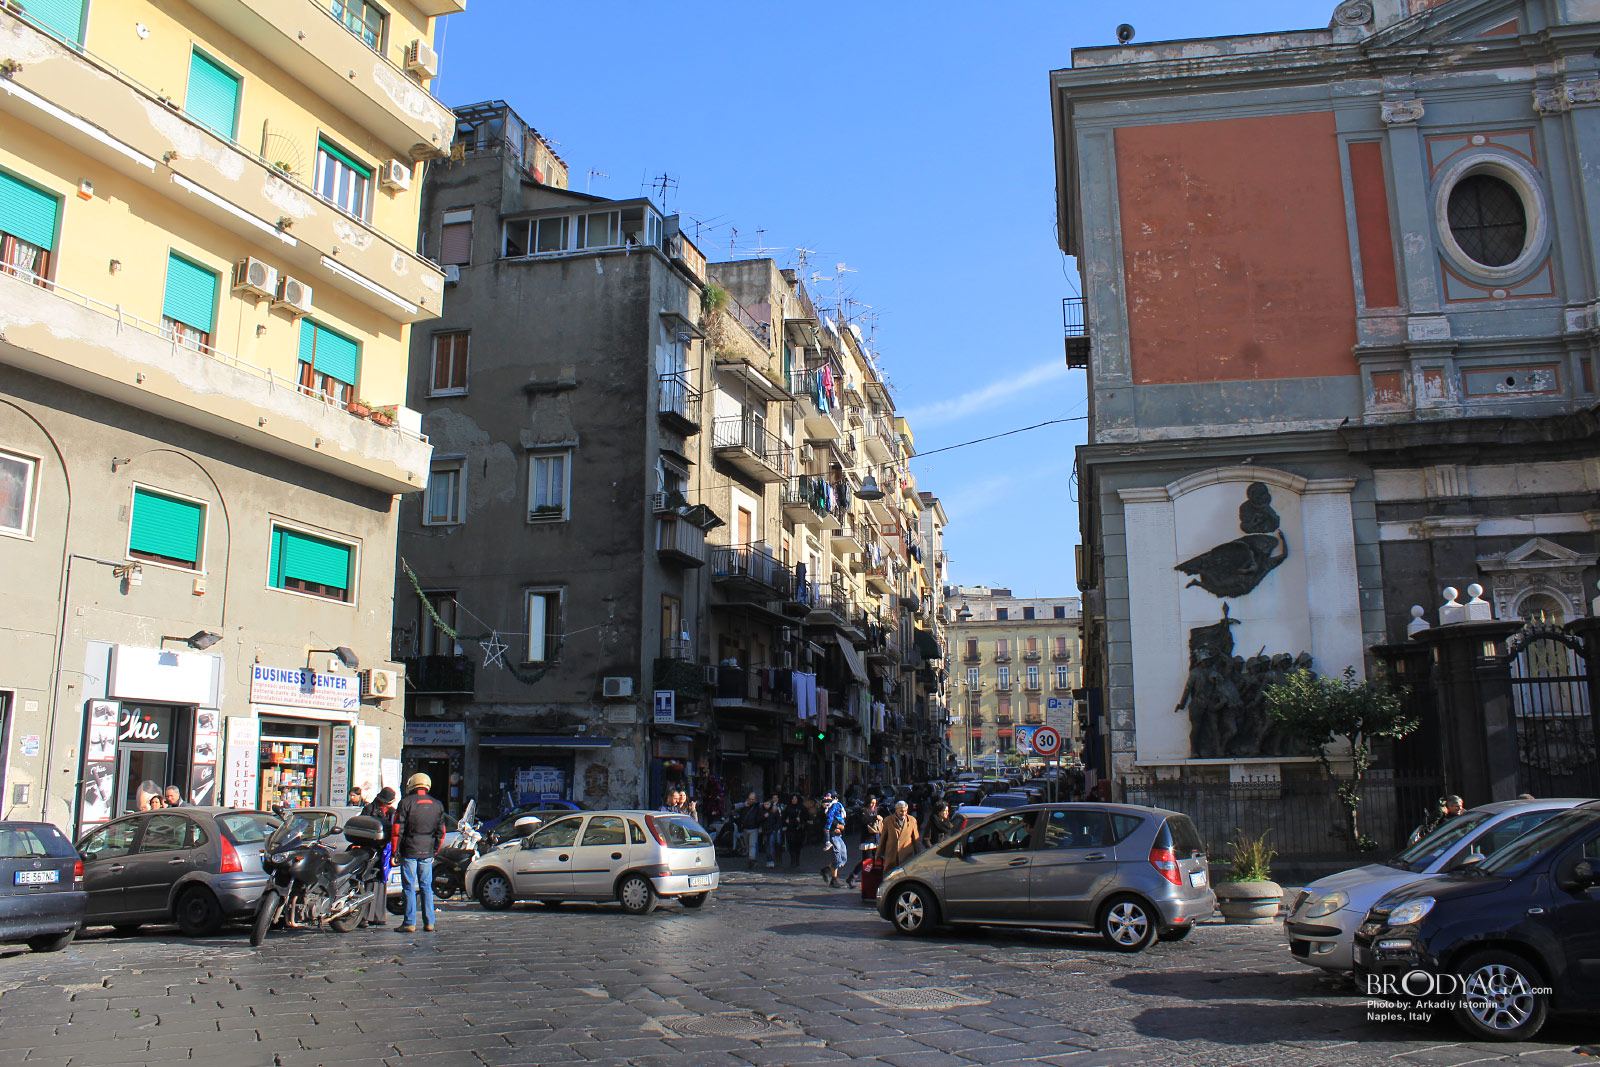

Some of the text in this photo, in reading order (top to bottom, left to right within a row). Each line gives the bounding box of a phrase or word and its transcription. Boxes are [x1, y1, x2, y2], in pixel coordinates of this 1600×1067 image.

[254, 667, 347, 690] BUSINESS CENTER
[119, 707, 160, 741] Chic
[1039, 734, 1054, 747] 30
